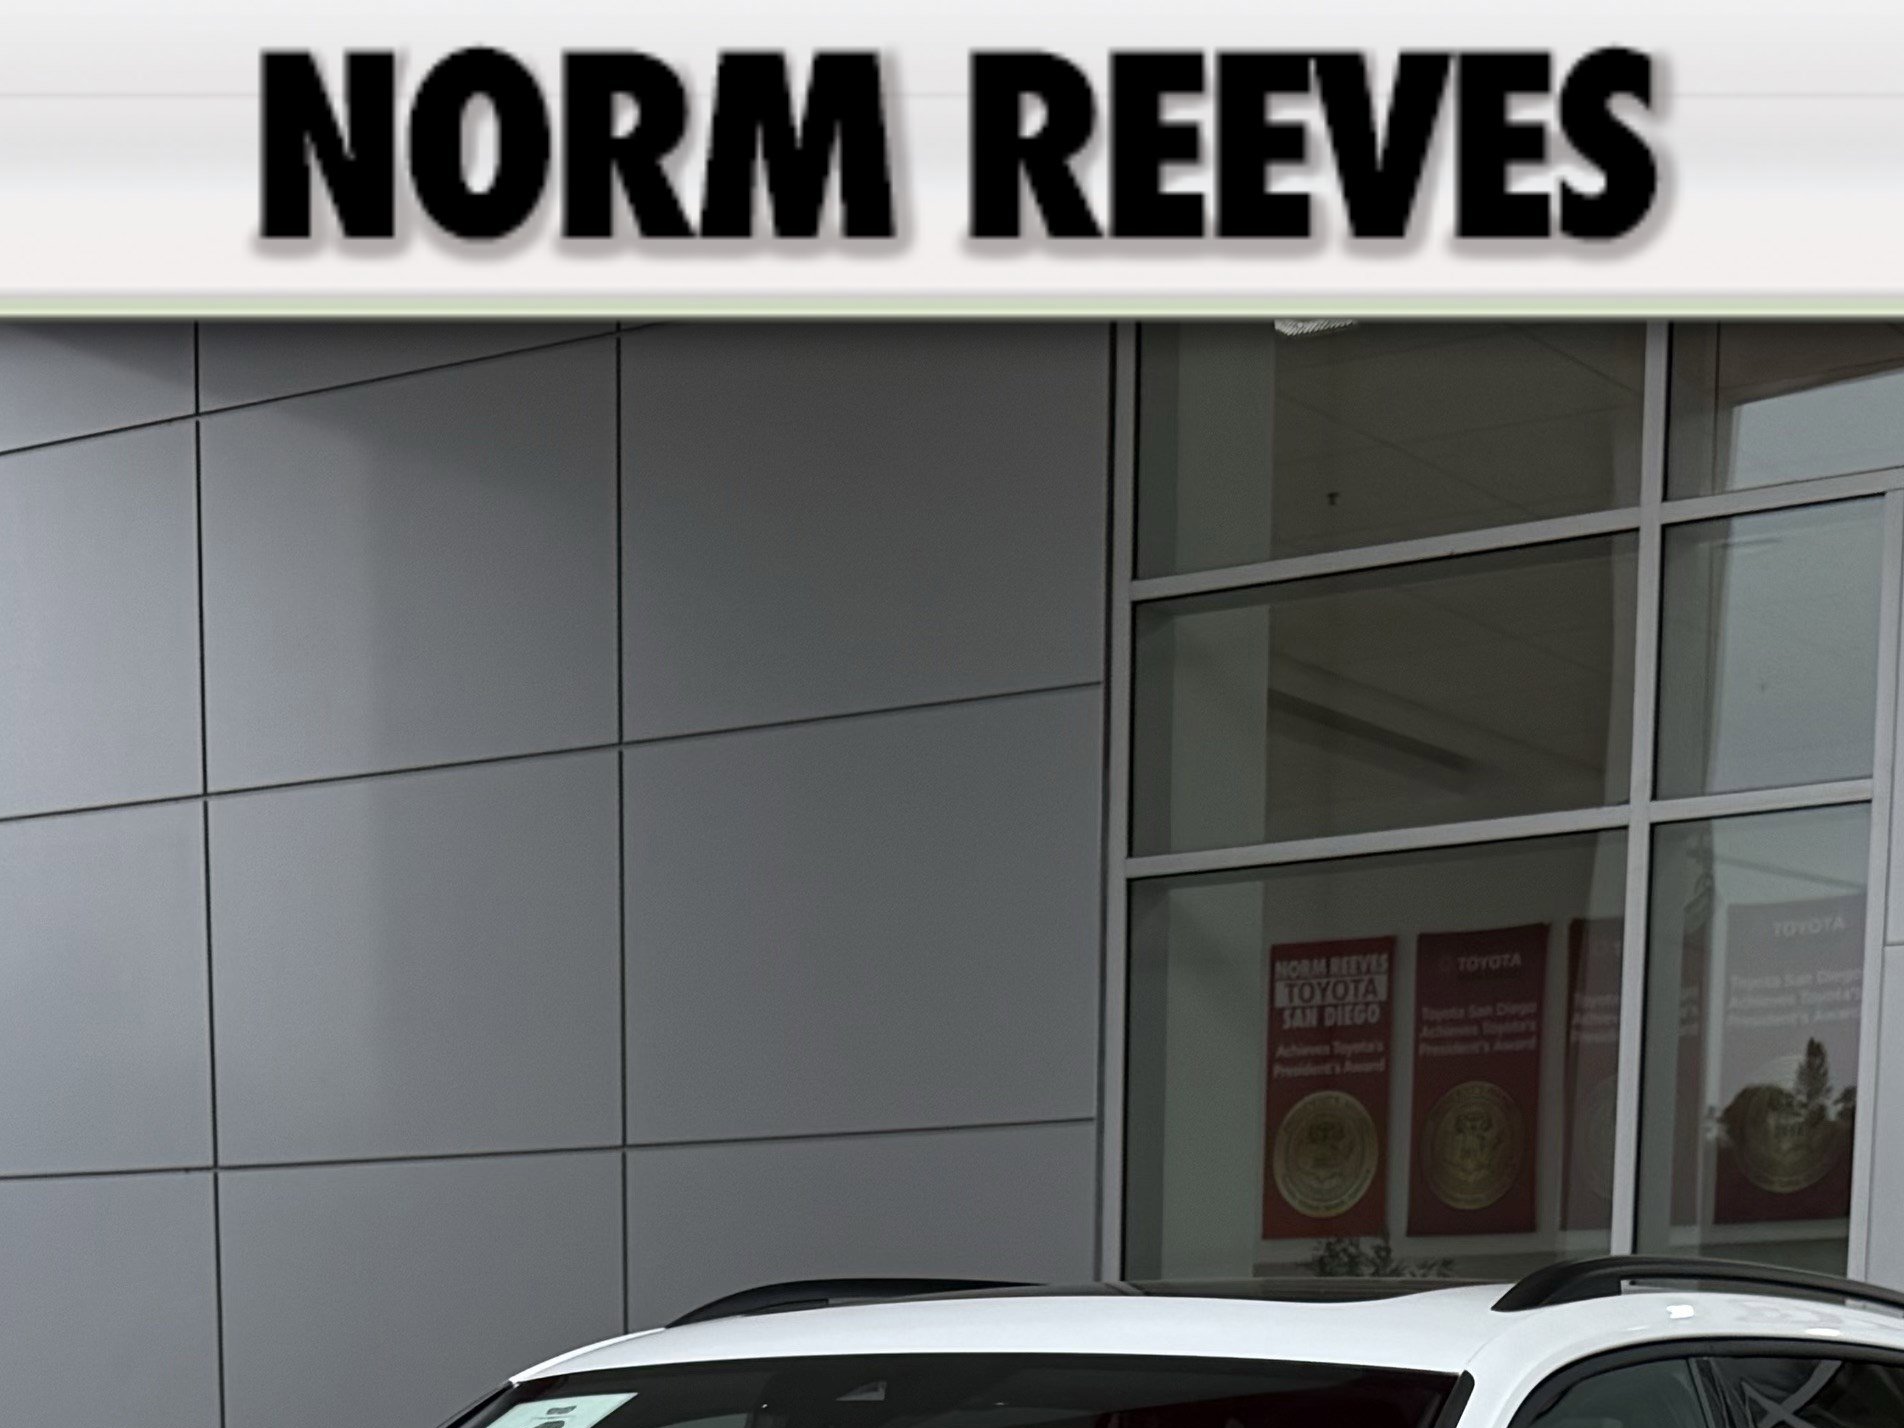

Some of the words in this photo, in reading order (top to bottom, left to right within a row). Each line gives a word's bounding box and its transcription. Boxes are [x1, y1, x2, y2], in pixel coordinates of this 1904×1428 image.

[1773, 917, 1846, 936] TOYOTA
[1274, 958, 1328, 980] NORM
[1329, 953, 1389, 976] REEVES
[1456, 952, 1522, 972] TOYOTA
[1284, 977, 1378, 1004] TOYOTA
[1282, 1006, 1318, 1030] SAN
[1324, 1003, 1381, 1027] DIEGO
